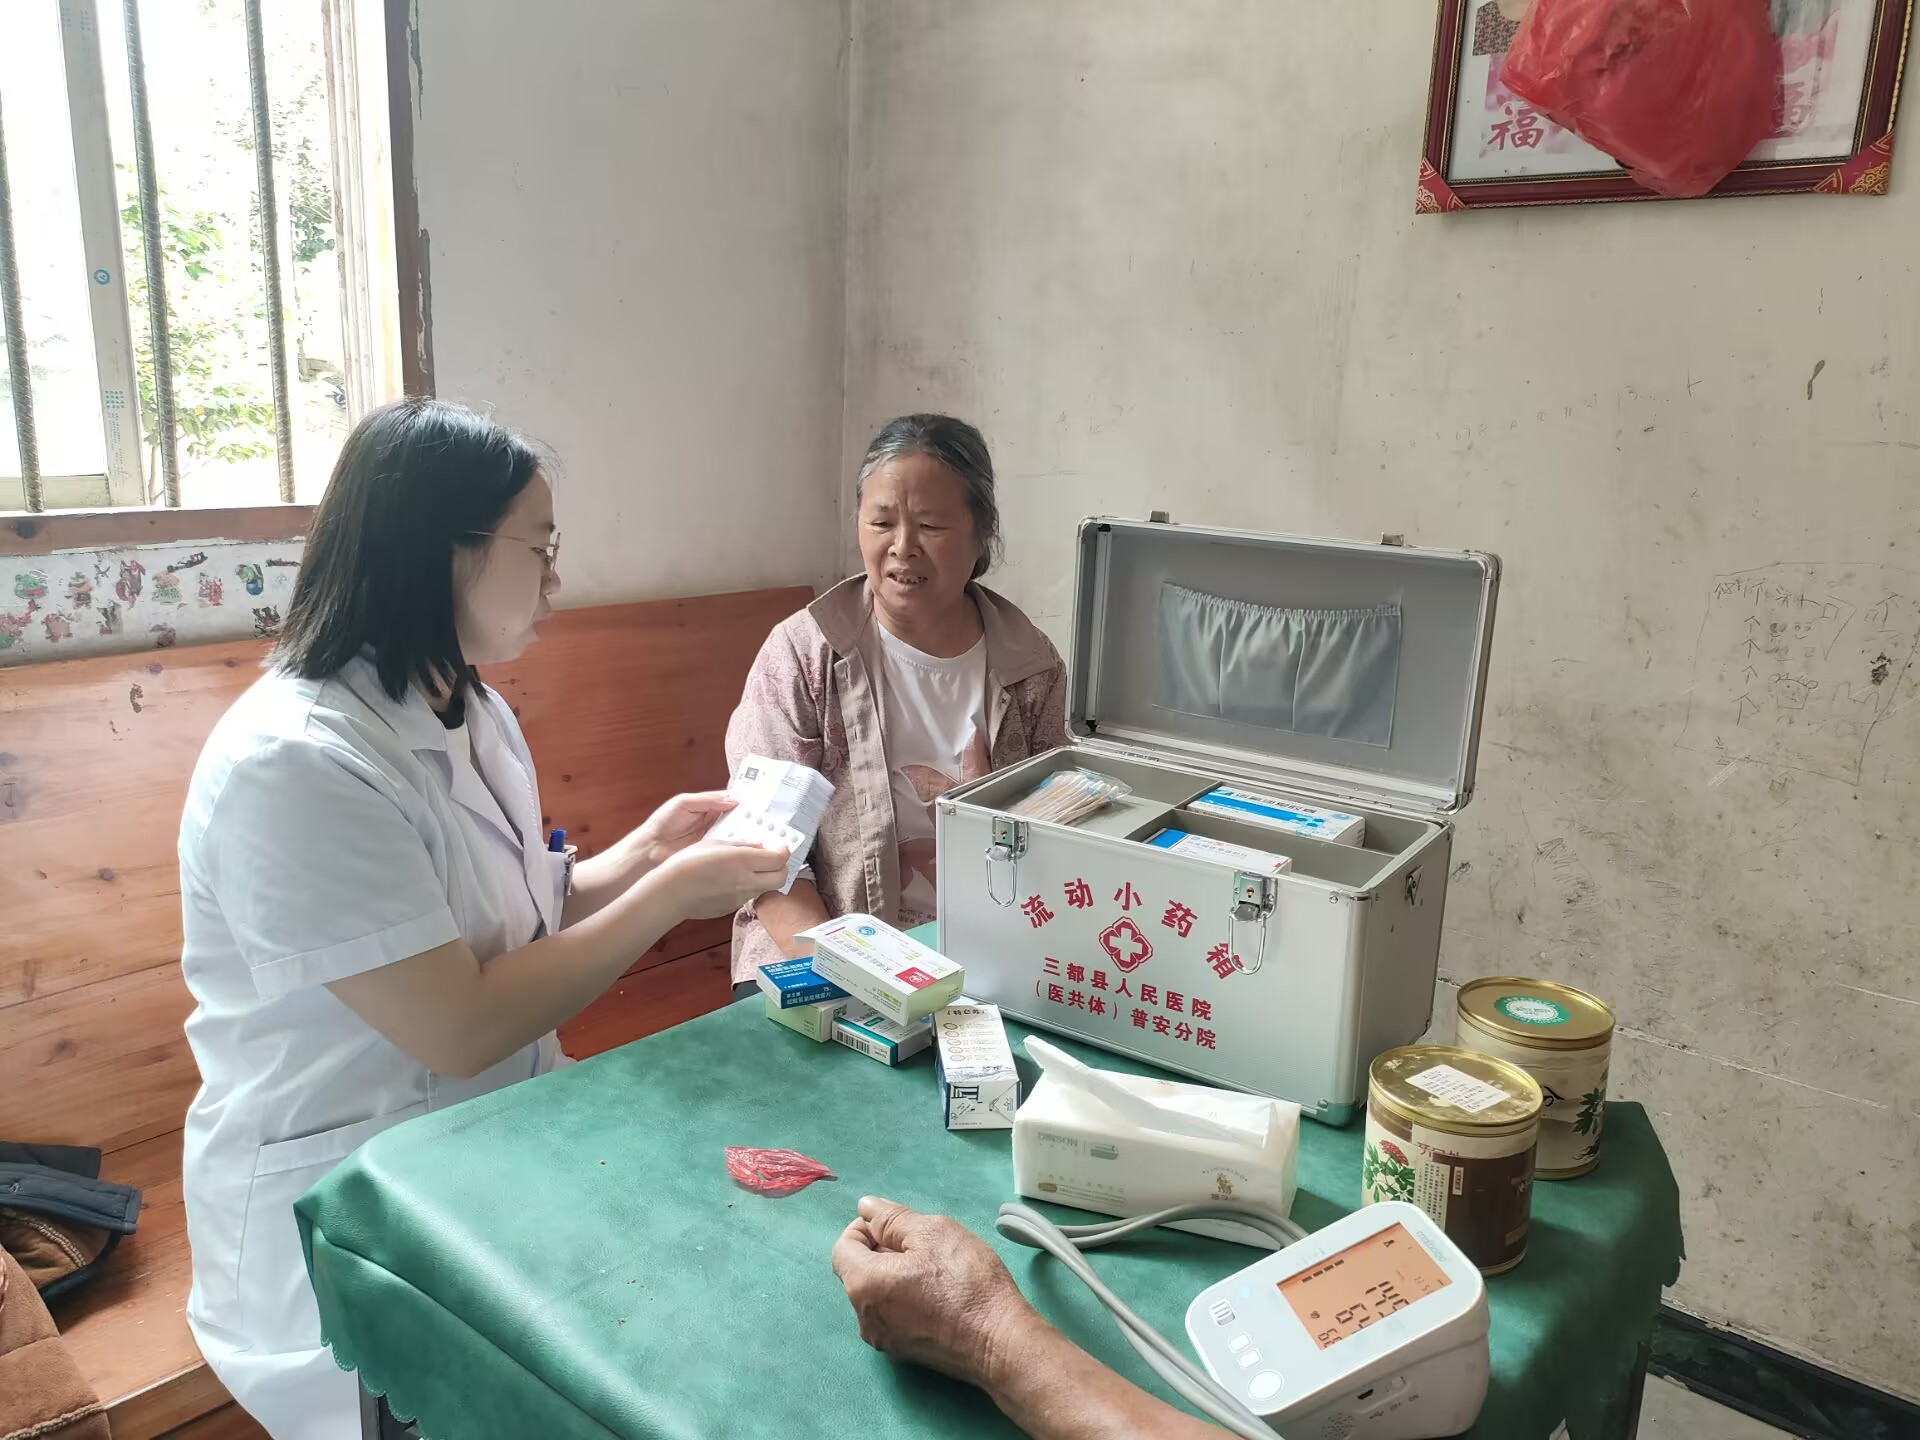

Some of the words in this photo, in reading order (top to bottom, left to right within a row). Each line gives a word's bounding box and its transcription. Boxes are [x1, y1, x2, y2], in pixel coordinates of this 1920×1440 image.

[1487, 104, 1545, 151] 福
[1020, 877, 1245, 980] 流动小药箱
[1034, 978, 1218, 1051] （医共体）普安分院
[1042, 956, 1213, 1021] 三都县人民医院
